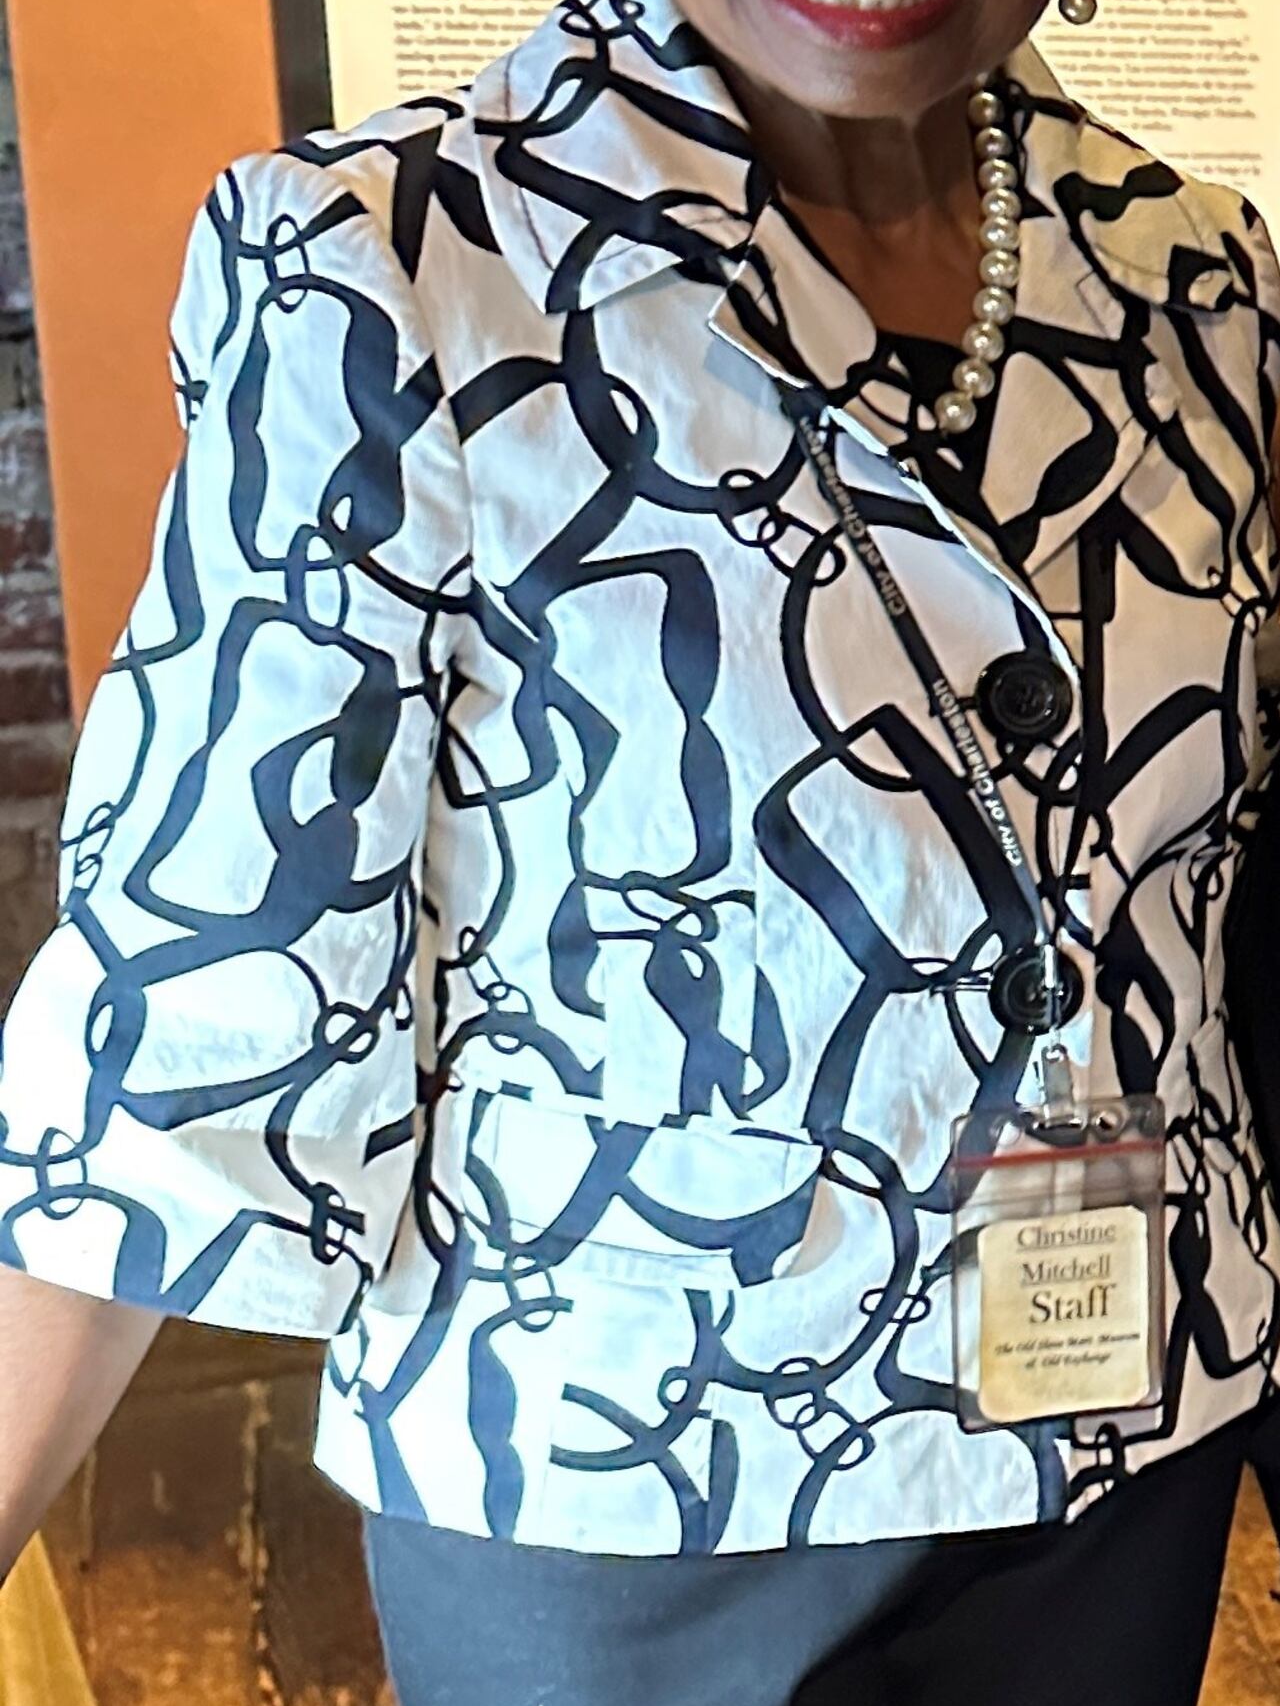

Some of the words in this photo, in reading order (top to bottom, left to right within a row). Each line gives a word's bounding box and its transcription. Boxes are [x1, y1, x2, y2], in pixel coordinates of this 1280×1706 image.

[932, 677, 996, 796] Charleston
[984, 797, 1006, 821] of
[998, 824, 1022, 867] City
[1017, 1221, 1117, 1247] Christine
[1022, 1253, 1111, 1284] Mitchell
[1029, 1282, 1118, 1324] Staff
